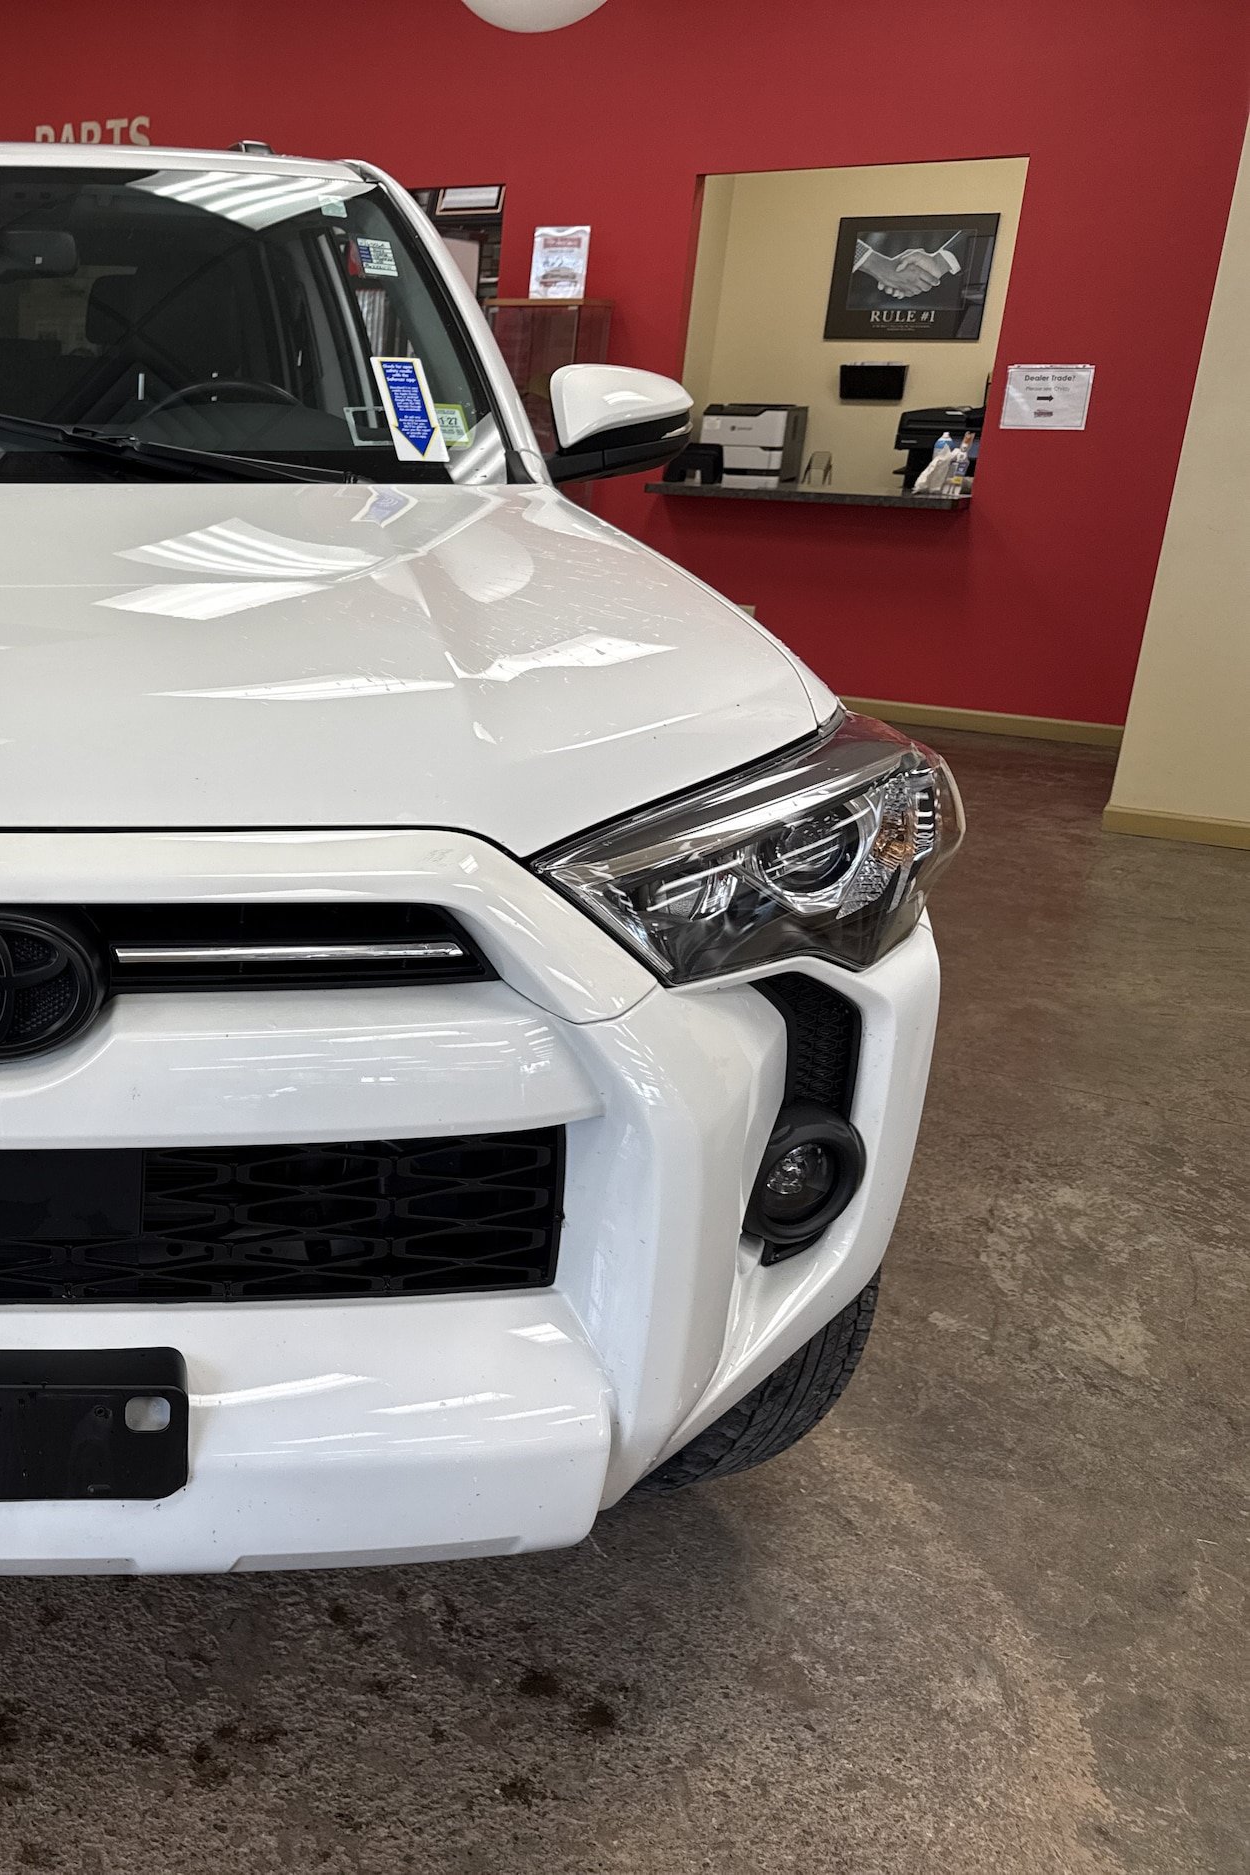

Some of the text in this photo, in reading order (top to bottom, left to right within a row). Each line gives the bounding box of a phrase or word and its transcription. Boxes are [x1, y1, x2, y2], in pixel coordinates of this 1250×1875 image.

[870, 310, 936, 323] RULE #1
[1024, 374, 1076, 382] Dealer Trade?
